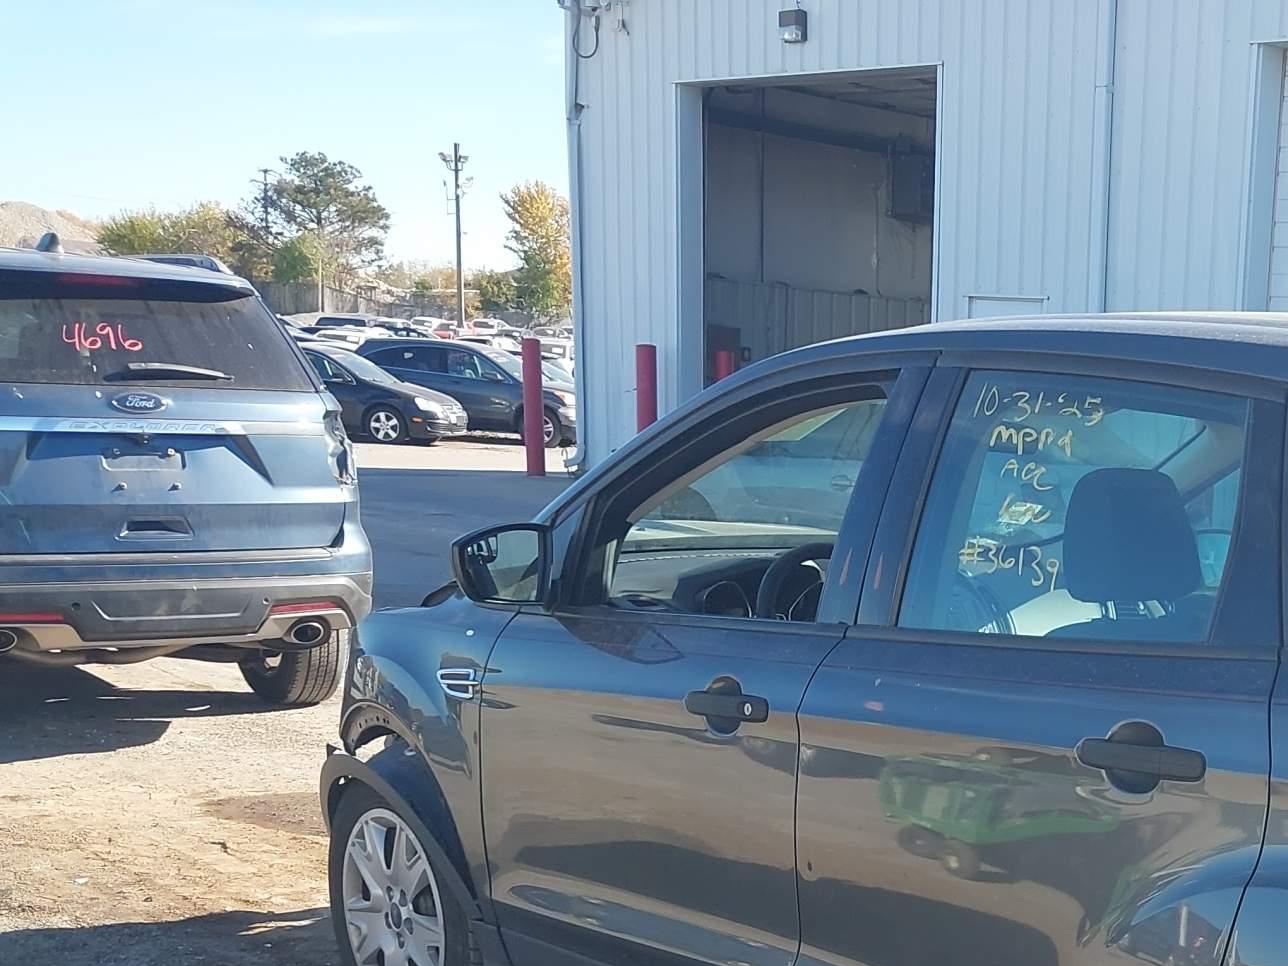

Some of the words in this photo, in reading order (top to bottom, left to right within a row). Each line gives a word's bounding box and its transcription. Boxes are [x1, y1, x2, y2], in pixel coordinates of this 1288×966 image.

[61, 322, 143, 351] 4696
[125, 394, 156, 409] Ford
[959, 536, 1059, 592] #36139
